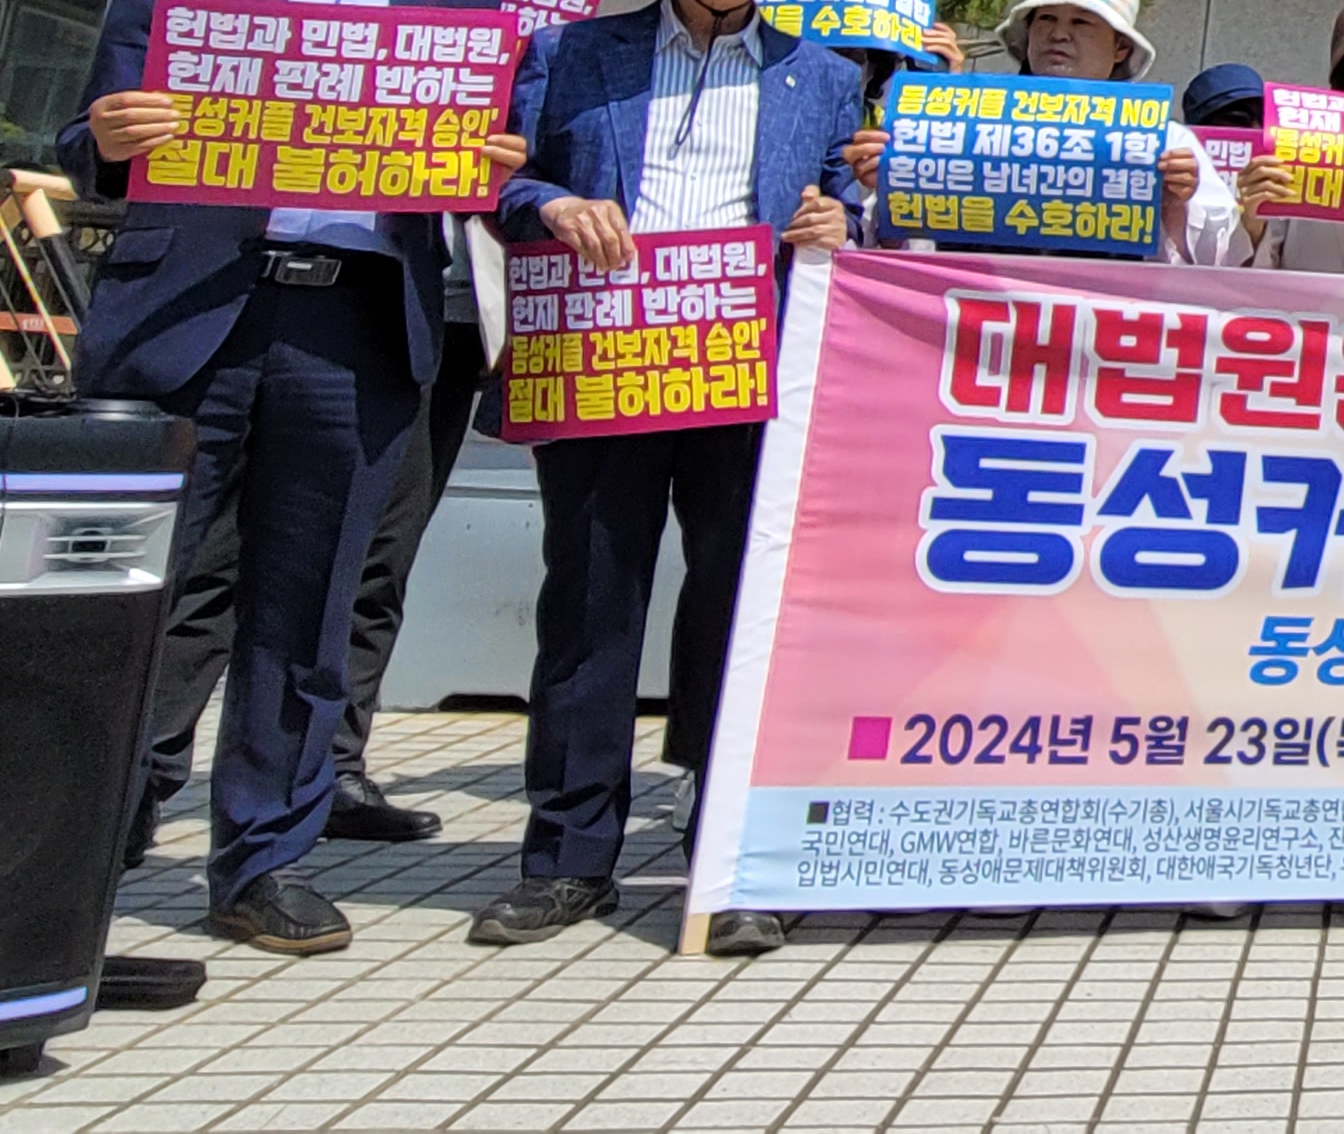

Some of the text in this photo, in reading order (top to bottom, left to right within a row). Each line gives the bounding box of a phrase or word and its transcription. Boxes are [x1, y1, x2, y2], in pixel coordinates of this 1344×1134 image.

[165, 7, 510, 65] 헌법과 민법, 대법원,
[167, 51, 493, 106] 헌재 판례 반하는
[304, 105, 428, 147] 건보자격
[897, 86, 1169, 130] 동성커플 건보자격 NO!
[1277, 107, 1341, 133] 헌재
[892, 119, 1160, 164] 헌법 제36조 1항
[273, 147, 491, 196] 불허하라!
[888, 156, 1156, 200] 혼인은 남녀간의 결합
[888, 192, 1153, 244] 헌법을 수호하라!
[509, 241, 767, 291] 헌법과 대법원,
[512, 282, 756, 332] 헌재 판례 반하는
[590, 325, 697, 370] 건보자격
[509, 362, 767, 423] 절대 불허하라!
[900, 714, 1093, 764] 2024년
[1109, 715, 1189, 764] 5월
